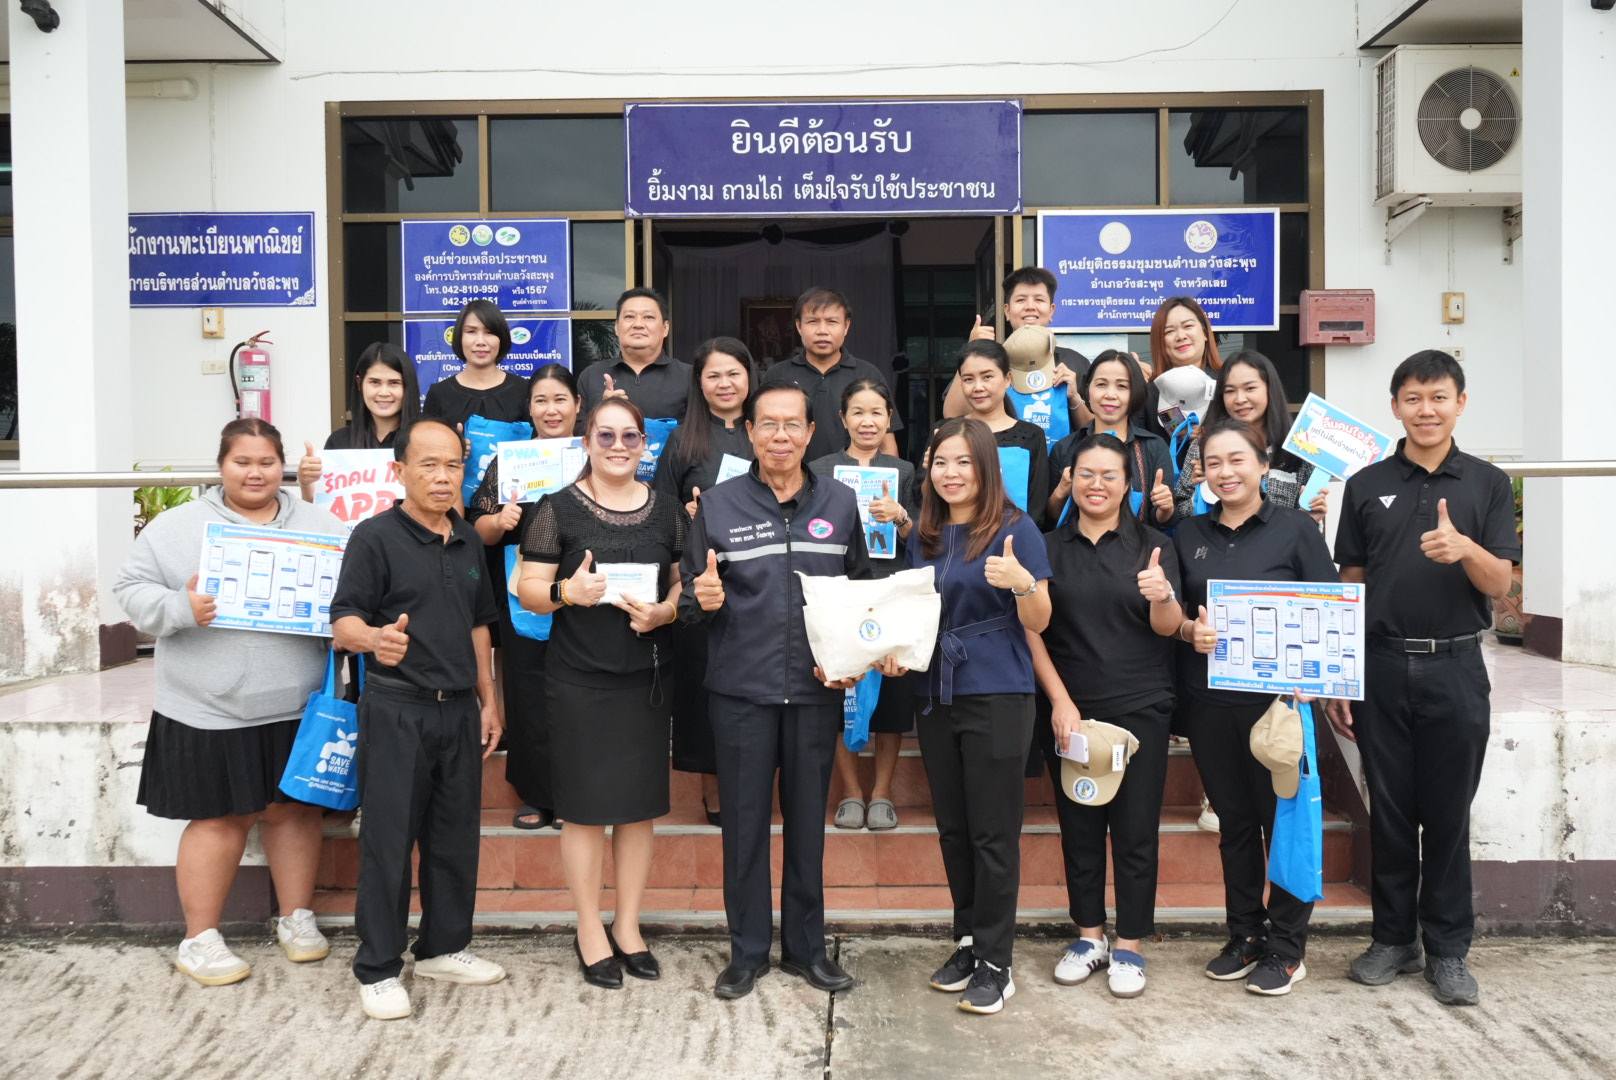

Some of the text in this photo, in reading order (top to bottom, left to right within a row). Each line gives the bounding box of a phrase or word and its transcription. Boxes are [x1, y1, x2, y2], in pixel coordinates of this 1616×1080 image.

[731, 117, 912, 154] ยินดีต้อนรับ
[648, 168, 995, 200] ยิ้มงาม ถามไถ่ เต็มใจรับใช้ประชาชน
[423, 251, 547, 269] ศูนย์ช่วยเหลือประชาชน
[1058, 255, 1257, 275] ศูนย์ยุติธรรมชุมชนตำบลวังสะพุง
[415, 269, 554, 283] องค์การบริหารส่วนตำบลวังสะพุง
[424, 284, 441, 294] โทร.
[442, 285, 499, 294] 042-810-950
[525, 285, 547, 294] 1567
[1091, 277, 1227, 291] อำเภอวังสะพุง จังหวัดเลย
[1061, 296, 1136, 309] กระทรวงยุติธรรม
[329, 756, 351, 768] SAVE
